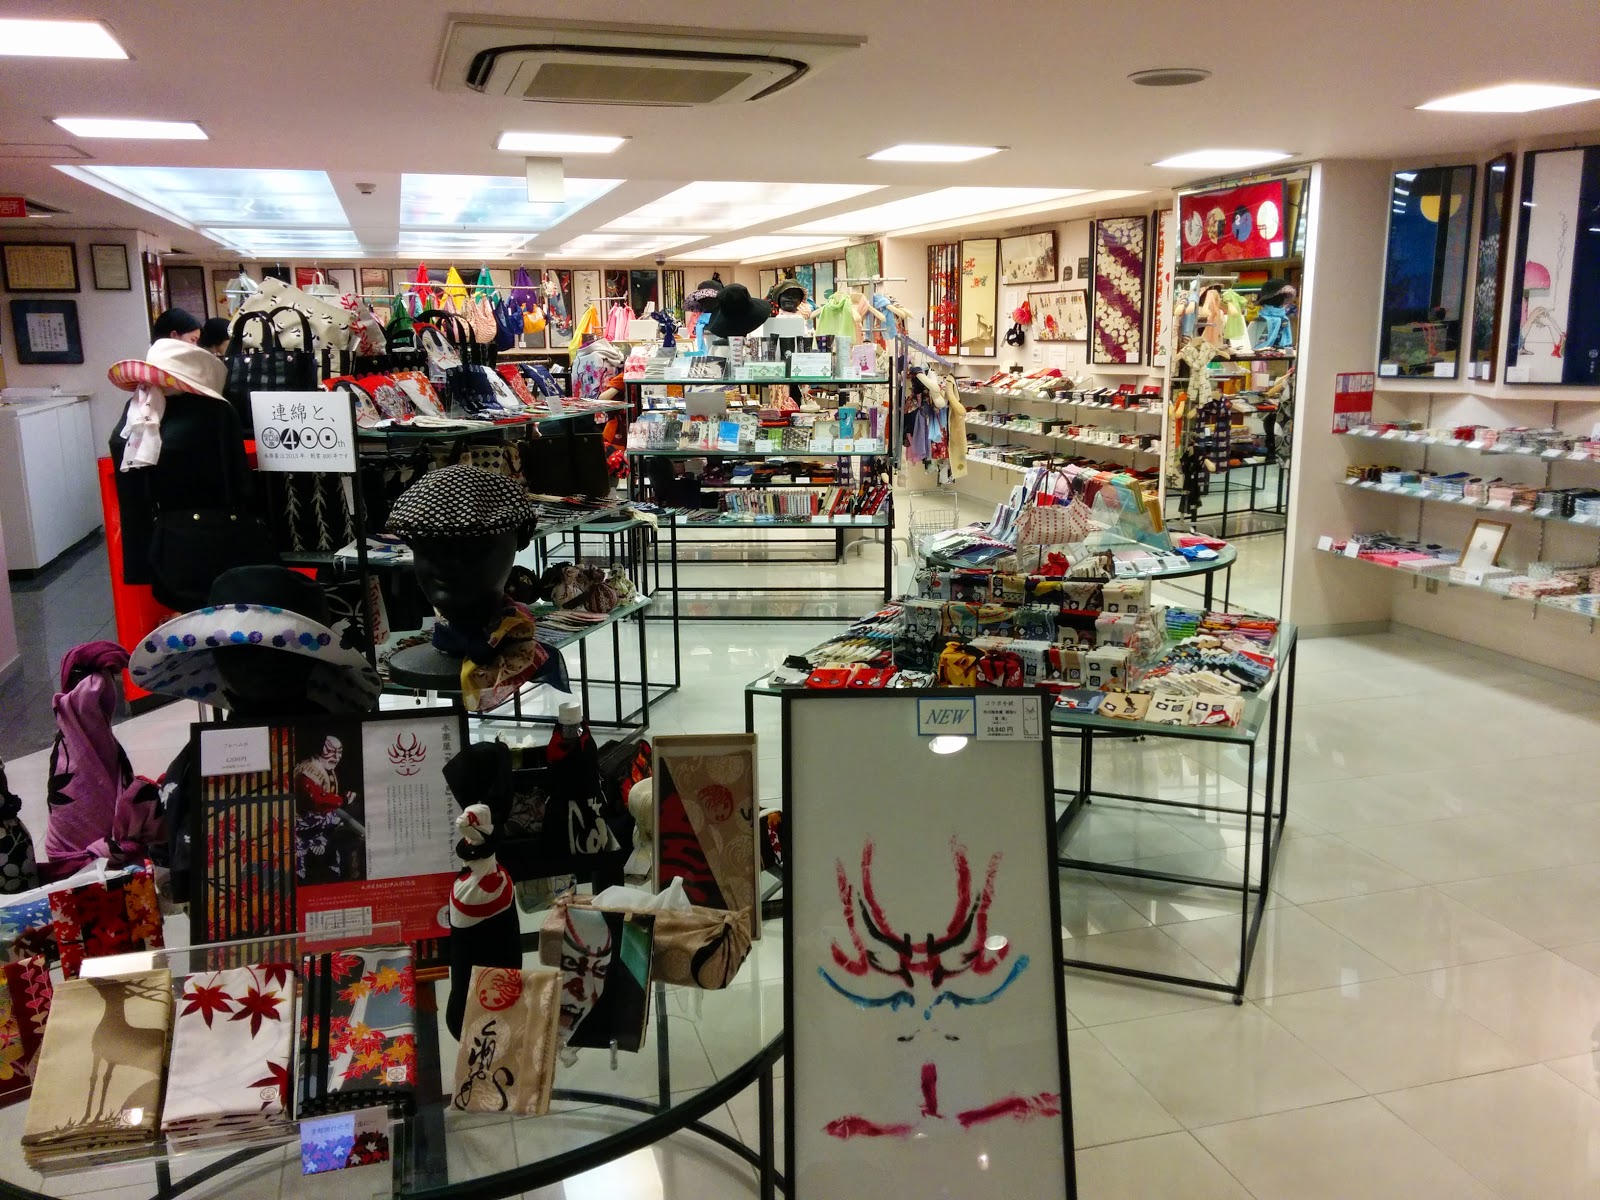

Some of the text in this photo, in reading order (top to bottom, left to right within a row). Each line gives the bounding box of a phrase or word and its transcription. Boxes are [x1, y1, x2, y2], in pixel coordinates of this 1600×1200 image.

[271, 402, 335, 424] 連綿と、
[925, 709, 970, 725] NEW
